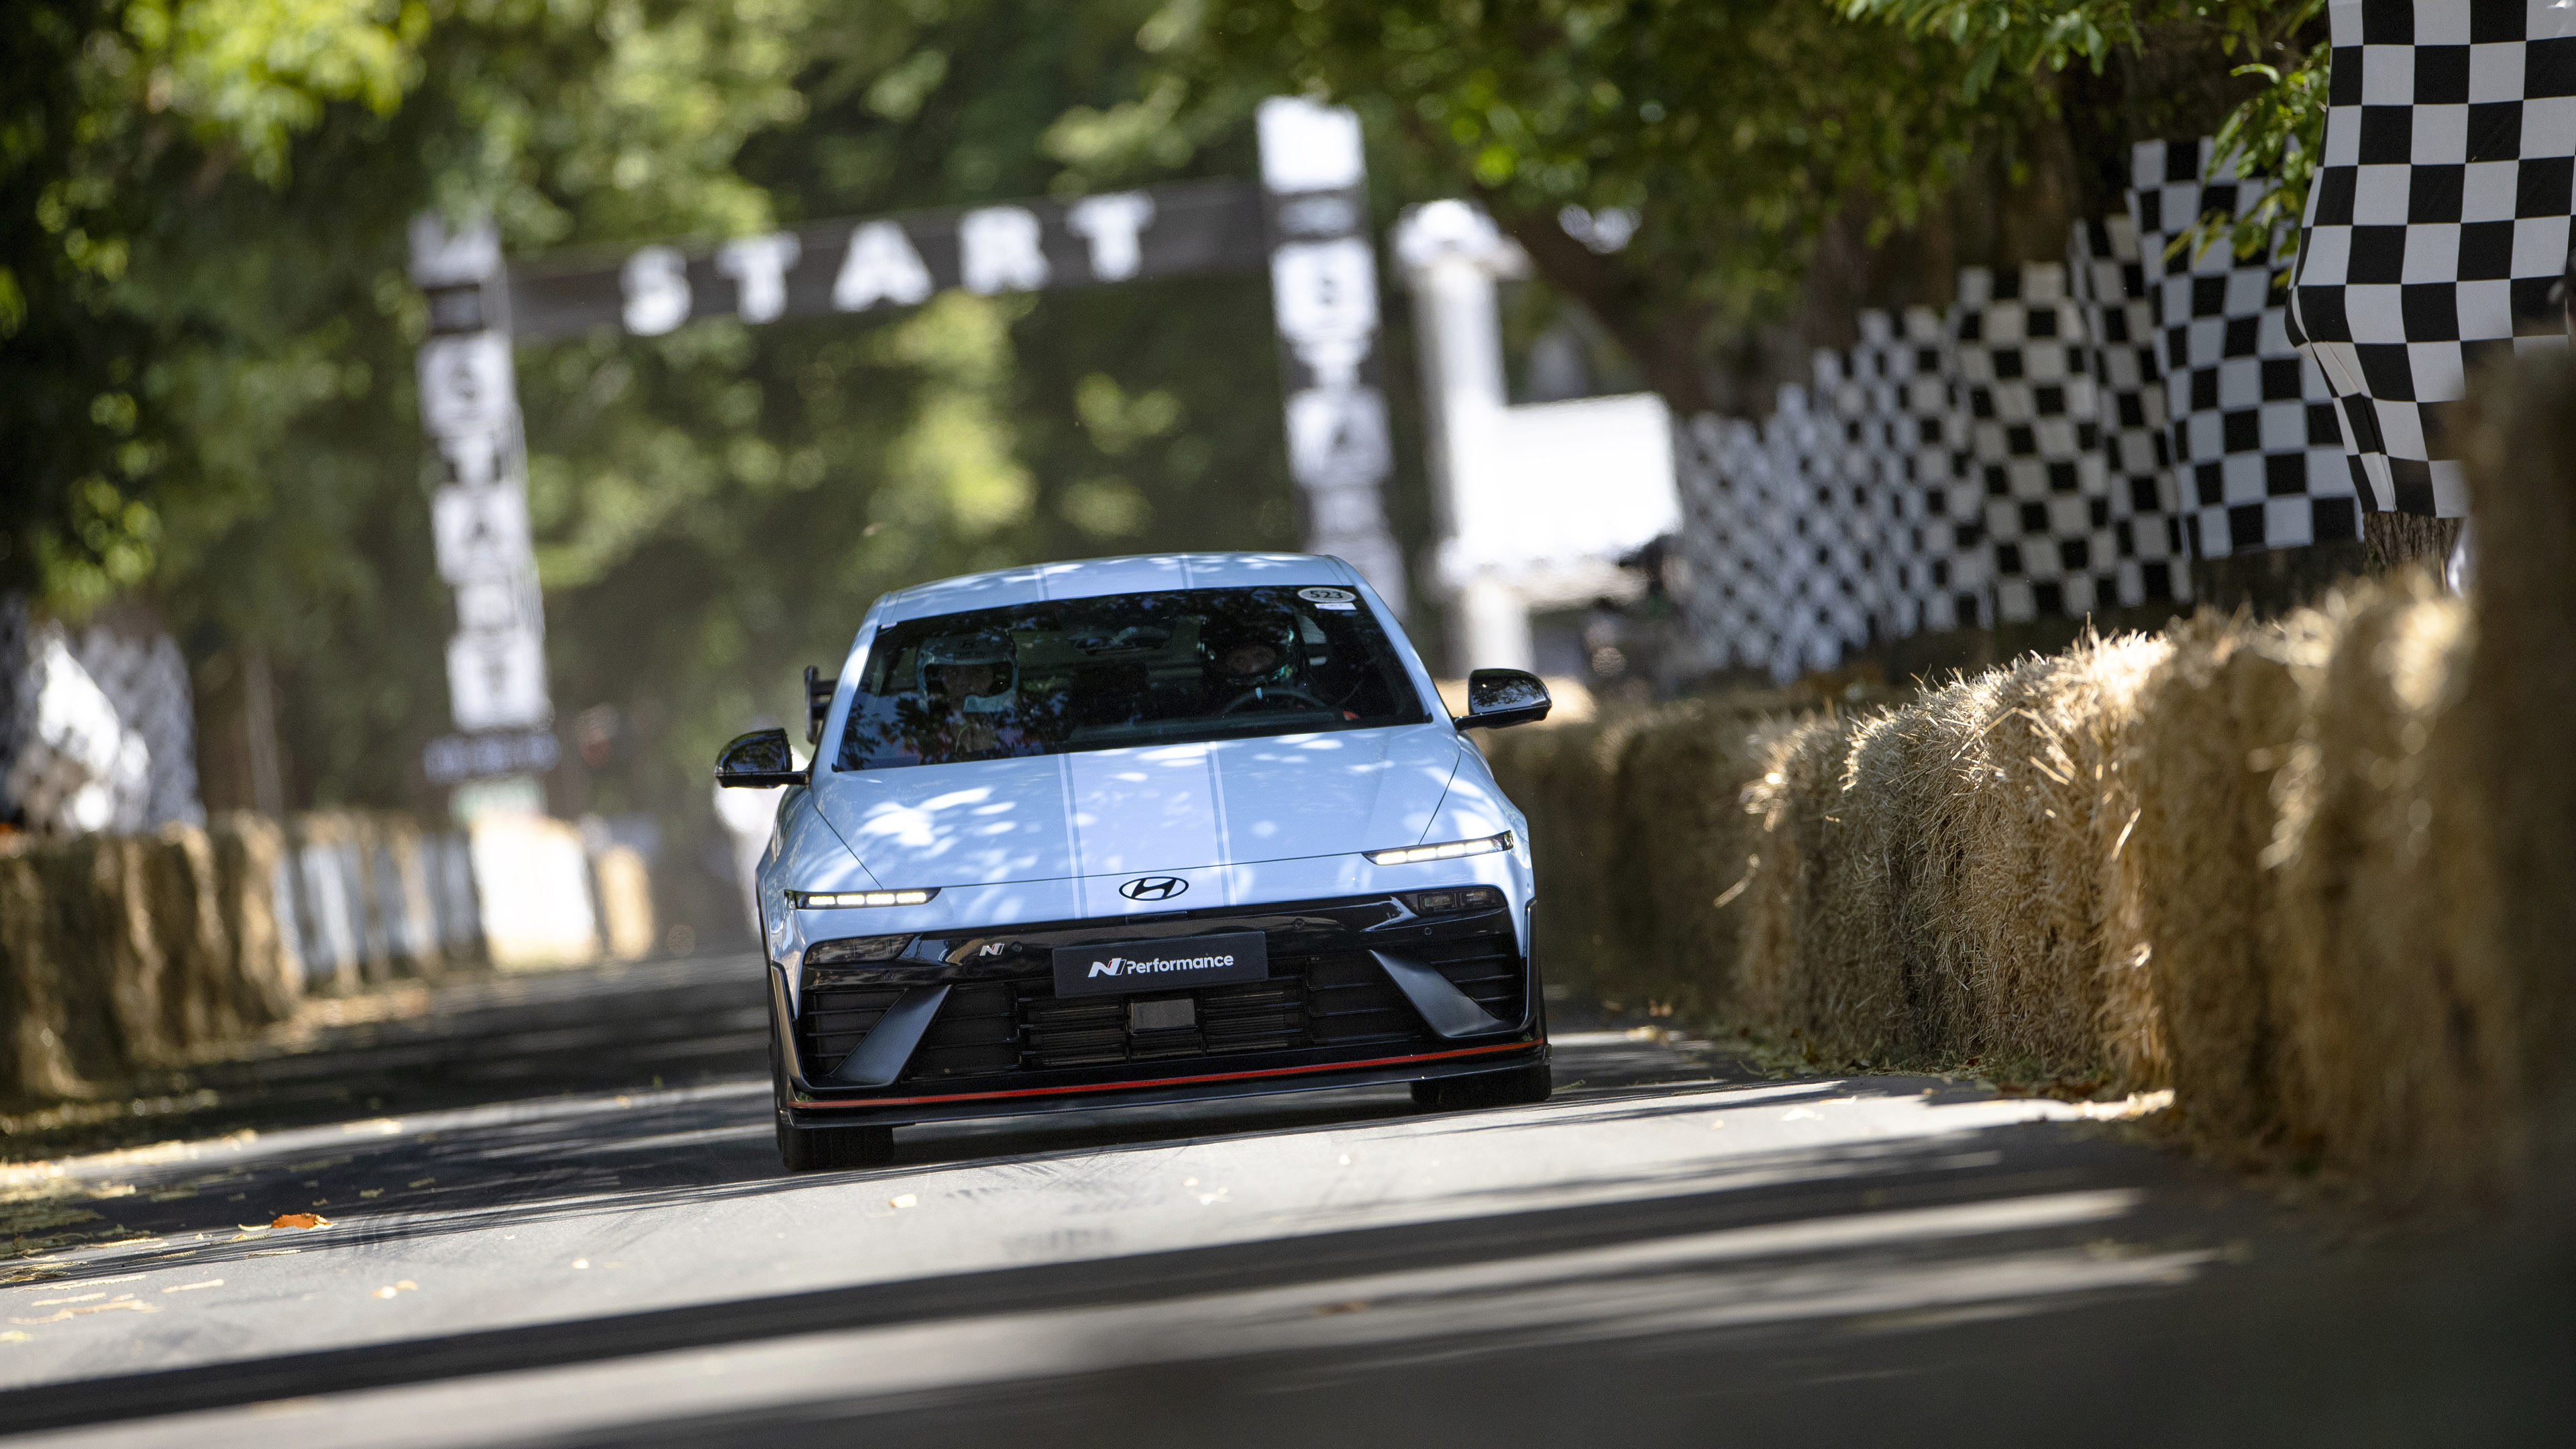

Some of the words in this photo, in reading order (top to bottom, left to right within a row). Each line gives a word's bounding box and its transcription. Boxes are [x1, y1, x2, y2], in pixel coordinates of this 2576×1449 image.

[620, 191, 1155, 335] START
[1309, 590, 1344, 598] 523
[1126, 955, 1234, 975] Performance
